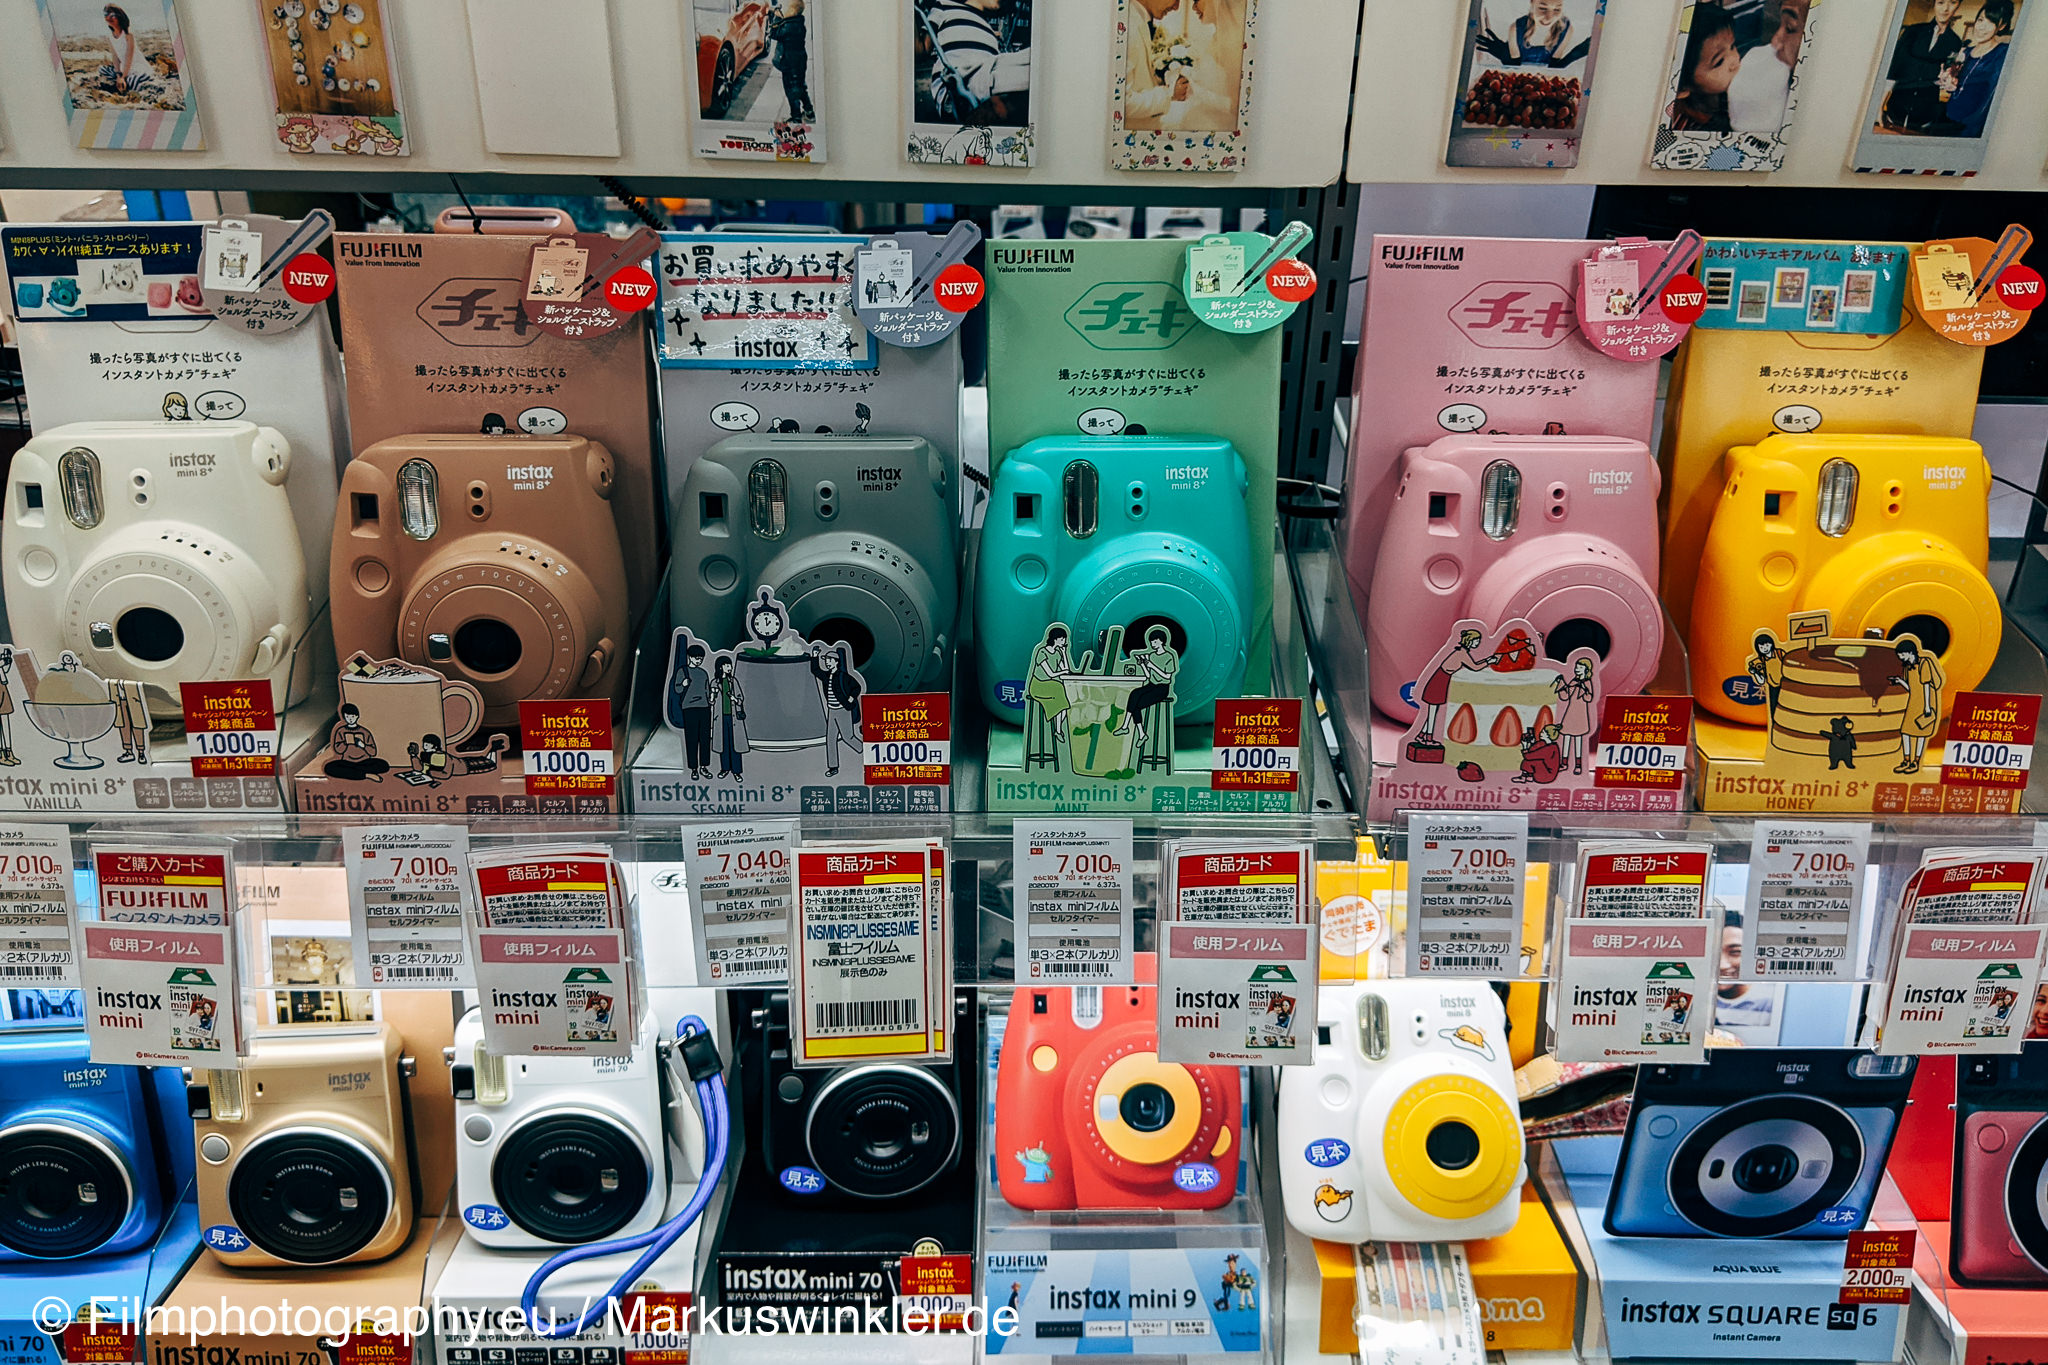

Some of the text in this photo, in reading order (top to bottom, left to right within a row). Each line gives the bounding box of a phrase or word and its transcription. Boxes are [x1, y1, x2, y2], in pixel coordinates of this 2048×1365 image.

[340, 242, 423, 258] FUJIFILM
[994, 249, 1074, 264] FUJIFILM
[1382, 246, 1464, 261] FUJIFILM
[663, 245, 856, 280] お買い求めやすく
[289, 272, 330, 287] NEW
[1272, 275, 1310, 287] NEW
[610, 282, 652, 297] NEW
[940, 282, 978, 296] NEW
[2002, 281, 2040, 296] NEW
[1665, 293, 1703, 308] NEW
[1079, 292, 1188, 338] チェキ
[1463, 292, 1574, 338] チェキ
[1942, 319, 2019, 333] ショルダーストラップ
[1972, 331, 1991, 341] 付き
[735, 336, 798, 358] instax
[1628, 345, 1647, 356] 付き
[1058, 368, 1206, 381] 撮ったら写真がすぐに出てくる
[1436, 366, 1586, 380] 撮ったら写真がすぐに出てくる
[1759, 365, 1909, 380] 撮ったら写真がすぐに出てくる
[206, 401, 233, 411] 撮って
[528, 417, 555, 428] 撮って
[721, 412, 748, 423] 撮って
[1088, 417, 1115, 427] 撮って
[1448, 413, 1475, 424] 撮って
[1783, 414, 1811, 425] 撮って
[857, 466, 902, 482] instax
[1165, 465, 1208, 480] instax
[1589, 470, 1632, 484] instax
[1923, 465, 1967, 480] instax
[1929, 482, 1947, 490] mini
[208, 719, 255, 729] 対象商品
[1957, 721, 2030, 731] キャッシュバックキャンペーン
[883, 729, 929, 739] 対象商品
[1234, 734, 1280, 745] 対象商品
[1620, 732, 1666, 743] 対象商品
[1967, 731, 2014, 742] 対象商品
[196, 733, 271, 755] 1,000円
[544, 737, 591, 748] 対象商品
[871, 743, 942, 763] 1,000円
[1221, 748, 1291, 768] 1,000円
[1605, 746, 1676, 768] 1,000円
[1953, 742, 2023, 767] 1,000円
[532, 752, 605, 773] 1,000円
[50, 778, 101, 795] mini
[1378, 777, 1447, 800] instax
[1454, 784, 1501, 802] mini
[1715, 772, 1784, 794] instax
[1792, 781, 1840, 797] mini
[24, 798, 82, 810] VANILLA
[305, 790, 375, 813] instax
[383, 794, 431, 811] mini
[692, 804, 745, 813] SESAME
[1054, 803, 1089, 813] MINT
[1766, 797, 1816, 810] HONEY
[1425, 825, 1482, 833] インスタントカメラ
[1768, 829, 1824, 837] インスタントカメラ
[361, 833, 419, 841] インスタントカメラ
[117, 857, 205, 872] ご購入カード
[827, 854, 897, 873] 商品カード
[1056, 854, 1120, 874] 7,010円
[1204, 855, 1272, 873] 商品カード
[1450, 849, 1515, 869] 7,010円
[1612, 856, 1679, 873] 商品カード
[1792, 853, 1855, 872] 7,010円
[390, 857, 458, 878] 7,010円
[507, 864, 579, 882] 商品カード
[1942, 864, 2005, 883] 商品カード
[107, 890, 208, 909] FUJIFILM
[716, 897, 783, 911] instax mini
[1422, 895, 1513, 906] instax miniフィルム
[1760, 898, 1849, 910] instax miniフィルム
[1442, 908, 1492, 916] セルフタイマー
[1780, 912, 1829, 920] セルフタイマー
[806, 920, 919, 940] INSMINI8PLUSSESAME
[9, 941, 40, 950] 使用電池
[109, 937, 201, 956] 使用フィルム
[827, 941, 900, 956] 富士フイルム
[1059, 938, 1090, 947] 使用電池
[1192, 936, 1284, 952] 使用フィルム
[1592, 933, 1683, 950] 使用フィルム
[1931, 937, 2016, 952] 使用フィルム
[503, 942, 596, 957] 使用フィルム
[839, 967, 888, 979] 展示色のみ
[97, 987, 162, 1011] instax
[492, 988, 557, 1008] instax
[1175, 987, 1240, 1008] instax
[1574, 985, 1638, 1006] instax
[1904, 984, 1967, 1004] instax
[100, 1013, 143, 1029] mini
[495, 1010, 540, 1025] mini
[1175, 1012, 1219, 1029] mini
[1572, 1010, 1617, 1026] mini
[1900, 1006, 1944, 1021] mini
[69, 1079, 102, 1089] mini 70
[1310, 1144, 1346, 1164] 見本
[786, 1170, 819, 1190] 見本
[1180, 1168, 1215, 1186] 見本
[469, 1208, 505, 1227] 見本
[209, 1229, 245, 1248] 見本
[988, 1255, 1048, 1267] FUJIFILM
[725, 1263, 883, 1290] instax mini 70
[1713, 1265, 1782, 1274] AQUA BLUE
[1846, 1269, 1904, 1286] 2,000円
[1050, 1285, 1196, 1310] instax mini 9
[1621, 1297, 1877, 1327] instax SQUARE SQ 6
[1487, 1331, 1495, 1342] 8
[1713, 1333, 1781, 1342] Instant Camera
[155, 1341, 239, 1365] instax
